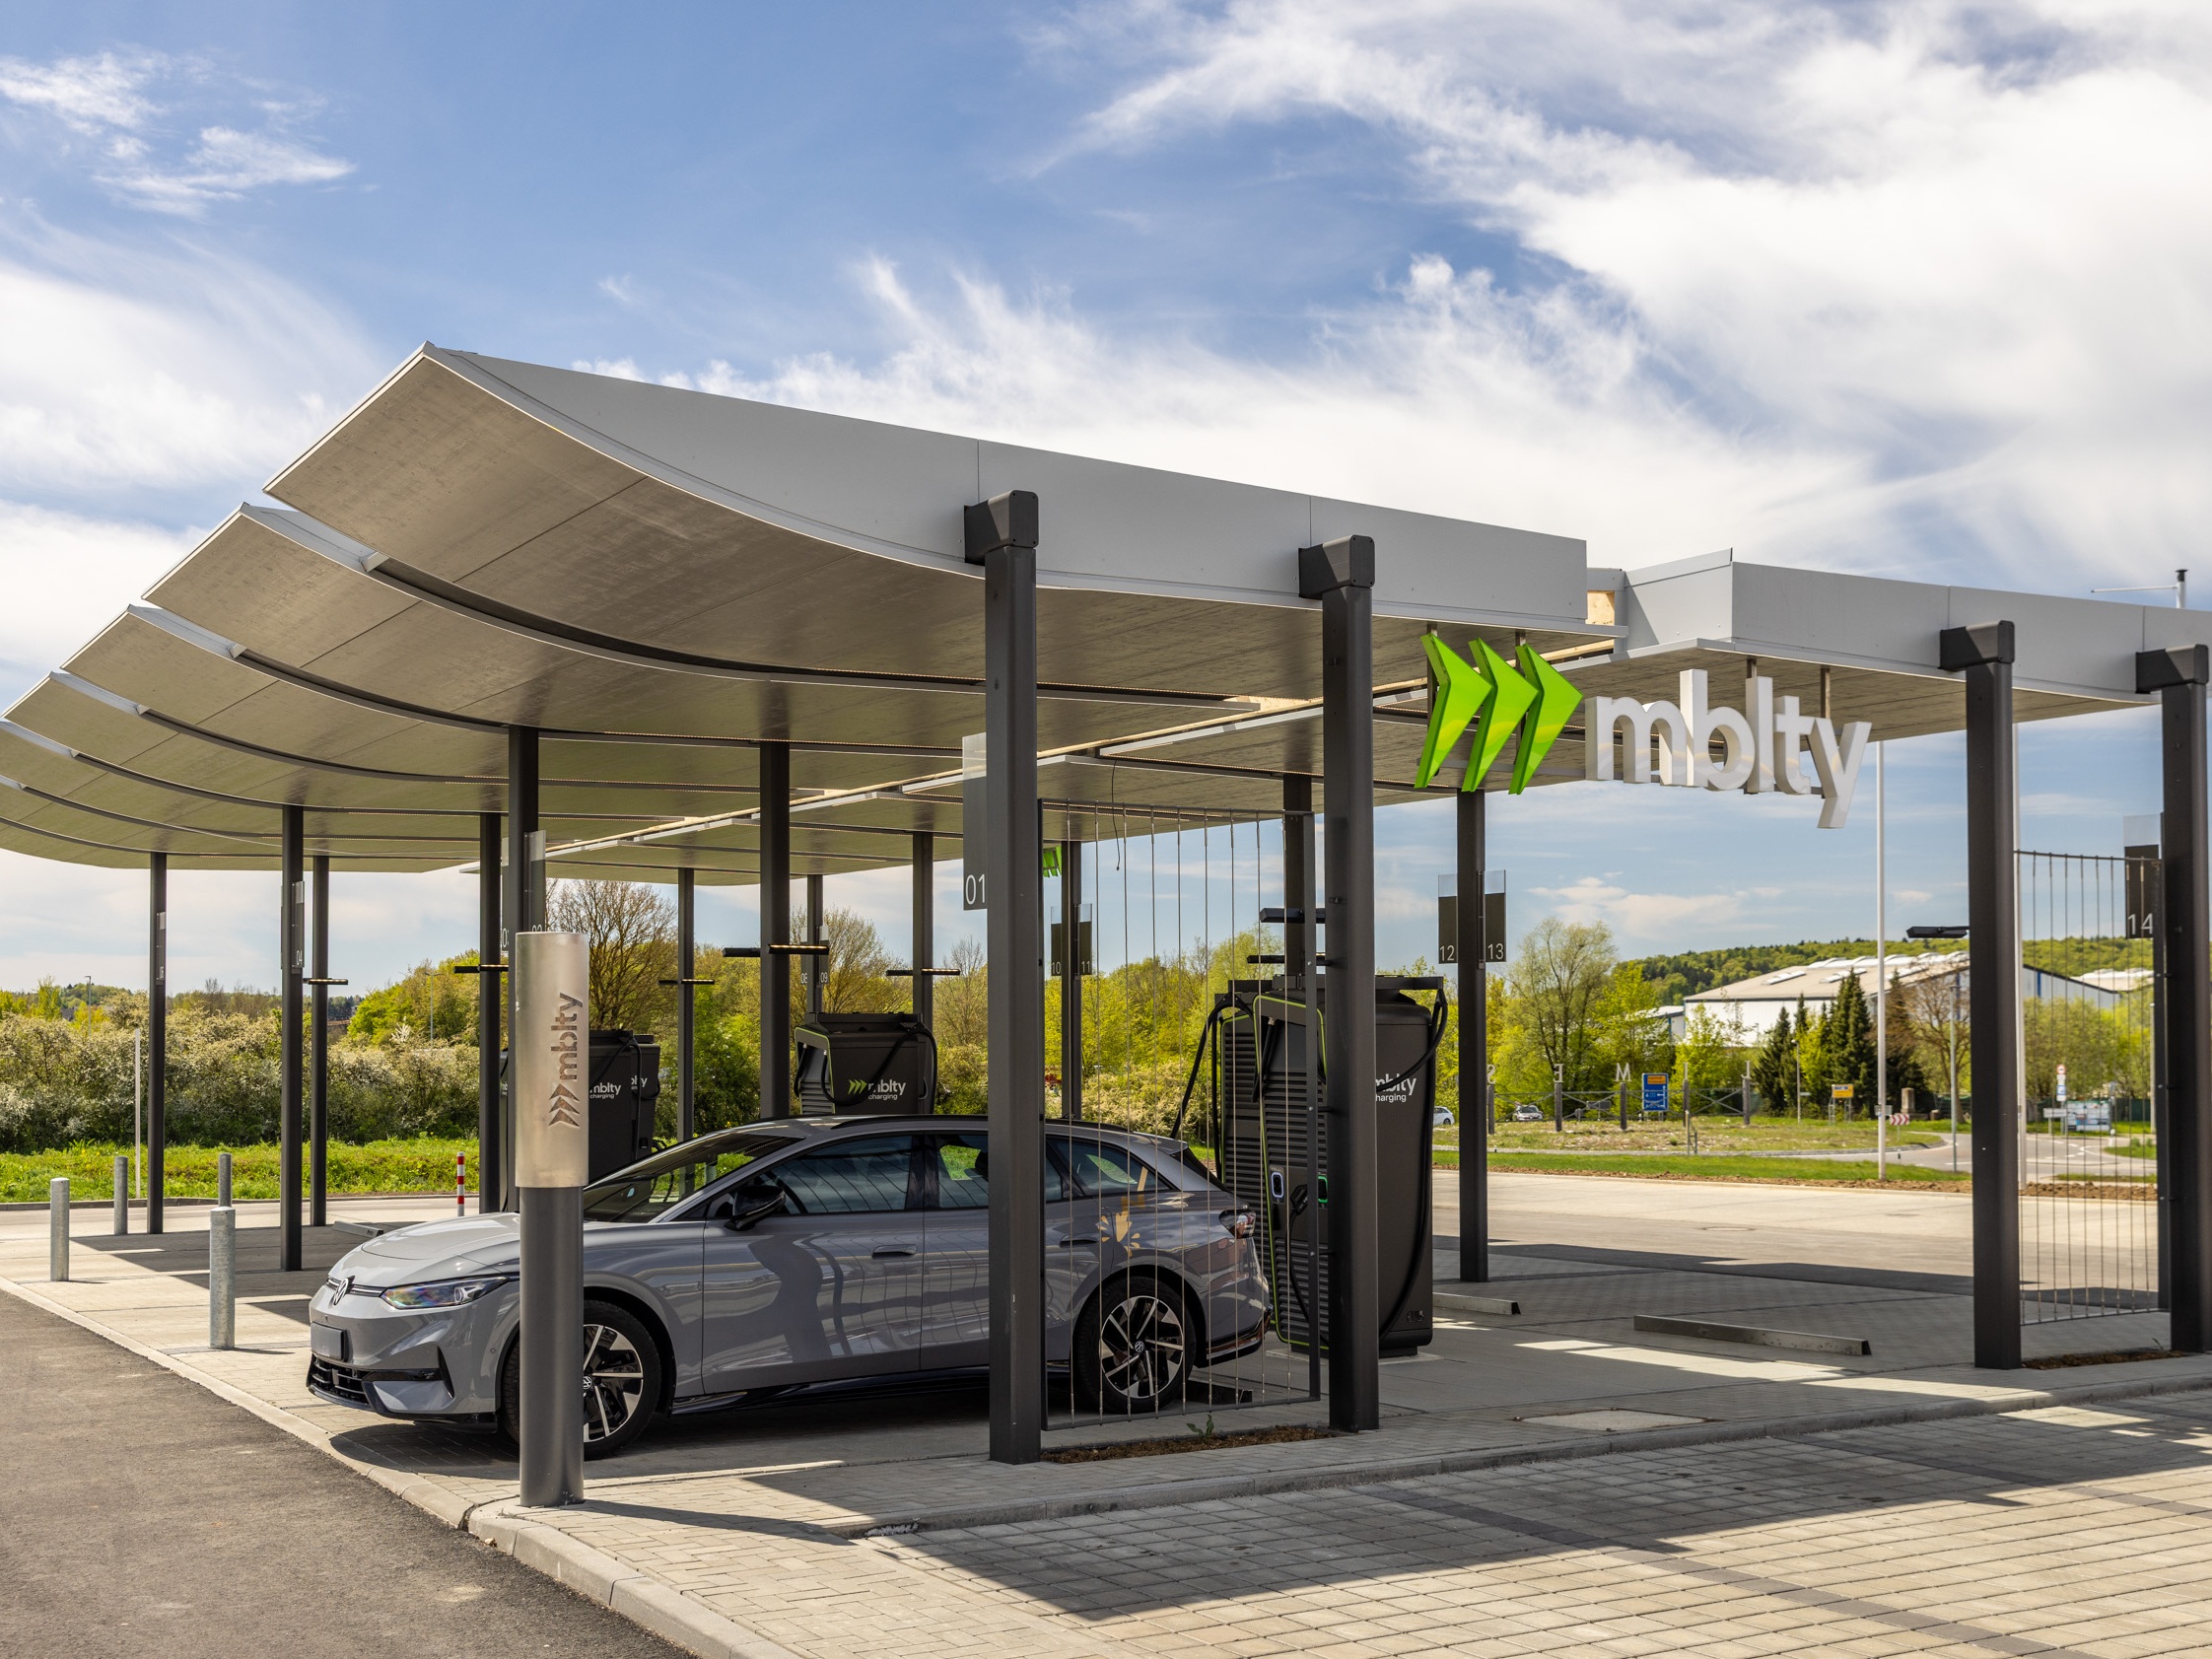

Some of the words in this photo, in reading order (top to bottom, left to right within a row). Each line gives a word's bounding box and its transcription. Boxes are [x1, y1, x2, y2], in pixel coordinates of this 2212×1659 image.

[1585, 669, 1872, 829] mblty
[966, 874, 985, 905] 01
[2128, 914, 2153, 934] 14
[1440, 945, 1454, 961] 12
[1488, 943, 1503, 959] 13
[1052, 962, 1061, 974] 10
[1081, 961, 1090, 973] 11
[551, 993, 583, 1080] mblty
[1375, 1093, 1407, 1103] harging
